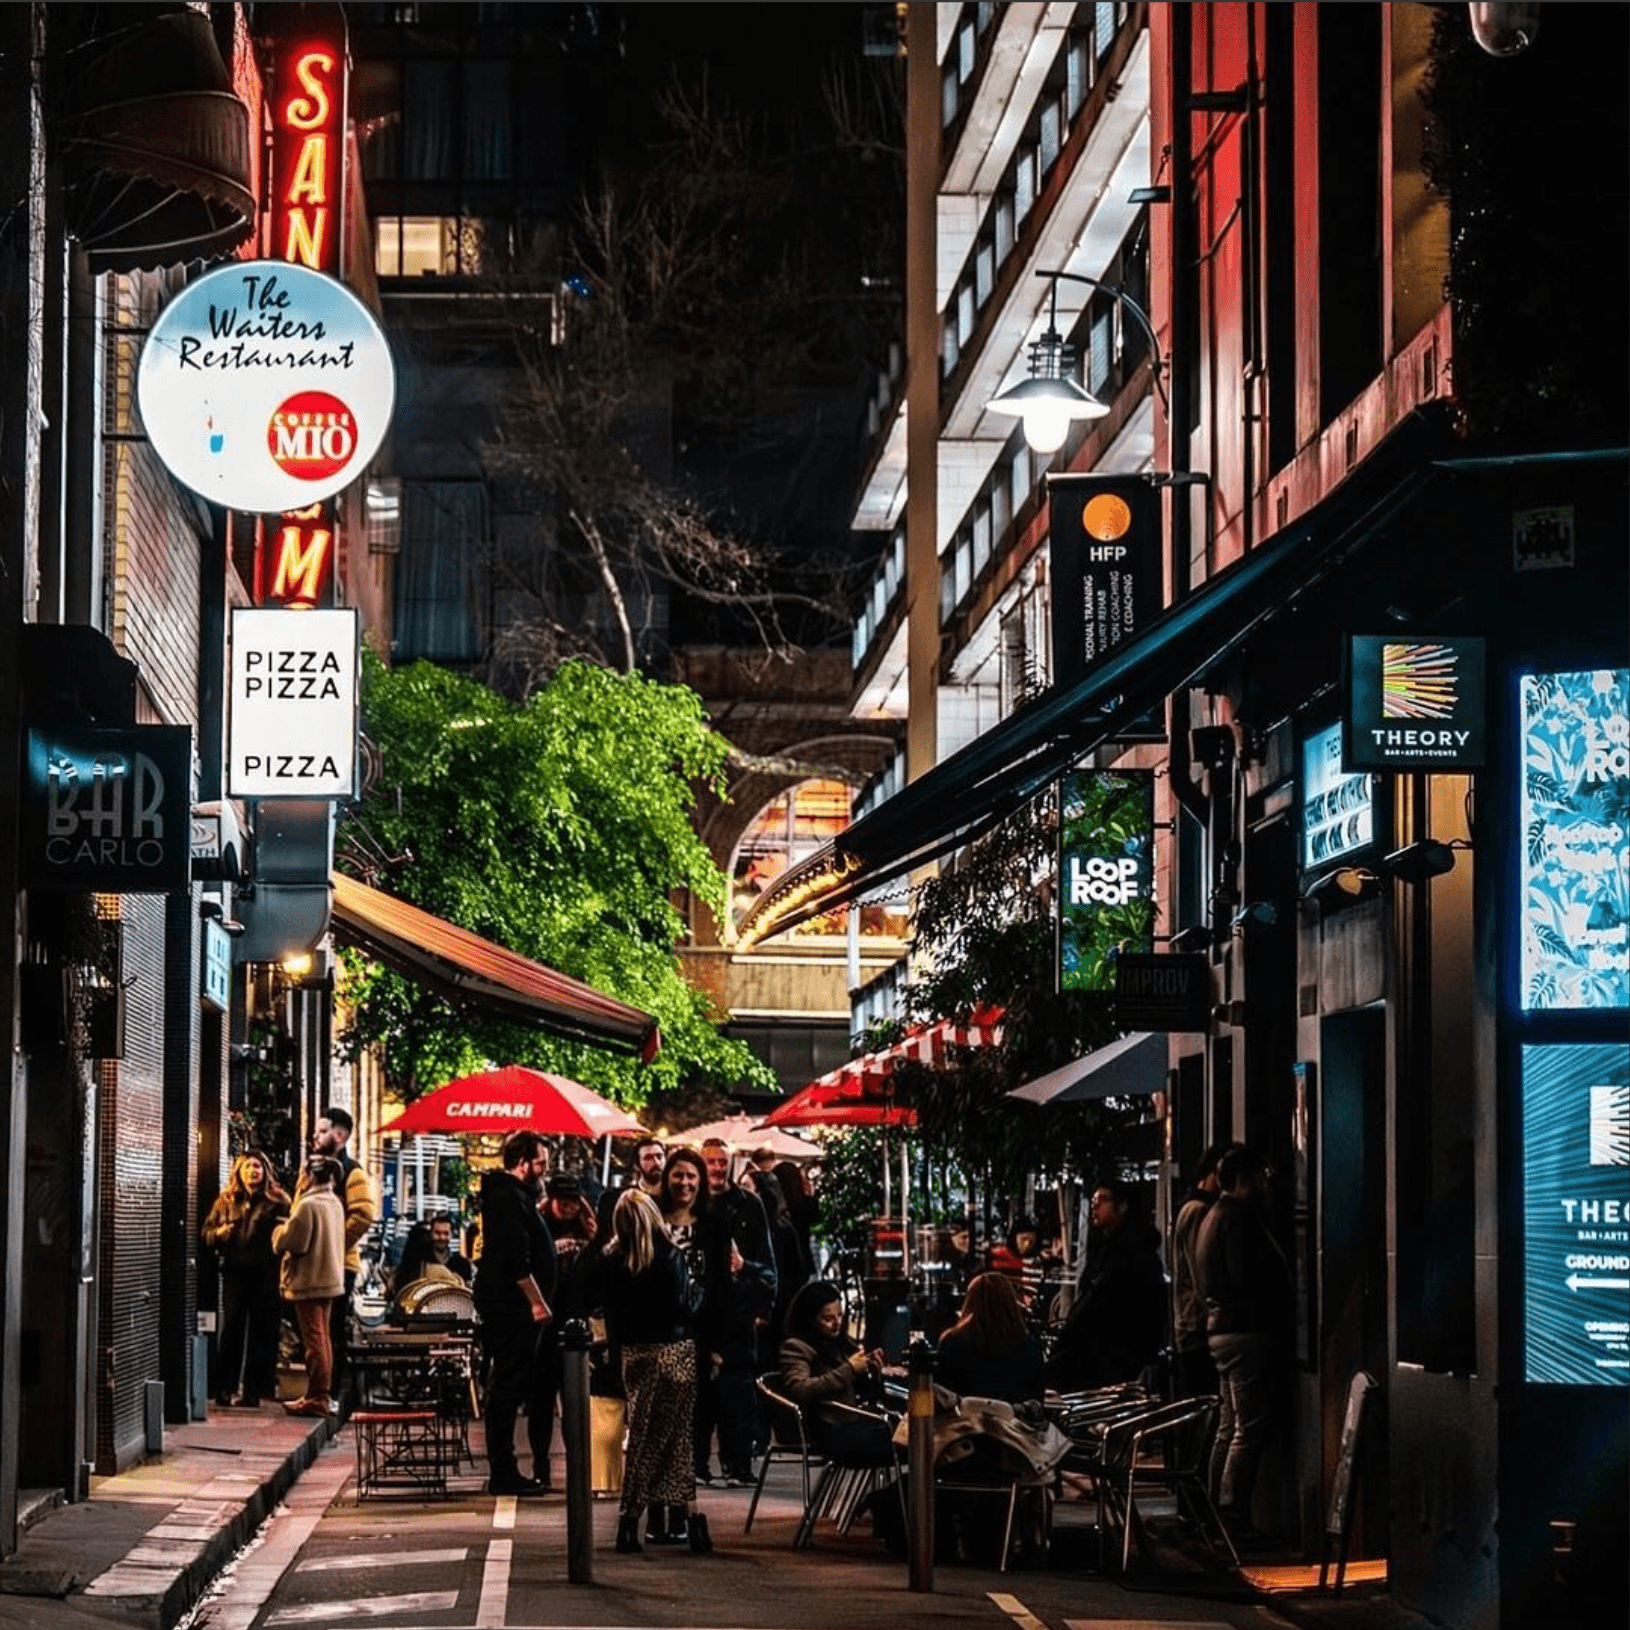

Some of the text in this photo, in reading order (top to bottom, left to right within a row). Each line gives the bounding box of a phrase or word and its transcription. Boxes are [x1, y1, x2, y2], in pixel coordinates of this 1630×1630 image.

[242, 276, 291, 310] The
[209, 304, 326, 340] Waiters
[179, 336, 354, 370] Restaurant
[274, 426, 352, 460] MIO
[1090, 546, 1127, 562] HFP
[246, 651, 340, 673] PIZZA
[245, 677, 340, 699] PIZZA
[1371, 729, 1470, 746] THEORY
[244, 755, 340, 778] PIZZA
[47, 747, 165, 838] BAR
[45, 837, 164, 867] CARLO
[1071, 857, 1138, 883] LOOP
[1071, 880, 1138, 905] ROOF
[1119, 968, 1190, 995] IMPROV
[446, 1103, 534, 1118] CAMPARI
[1565, 1254, 1629, 1270] GROUND
